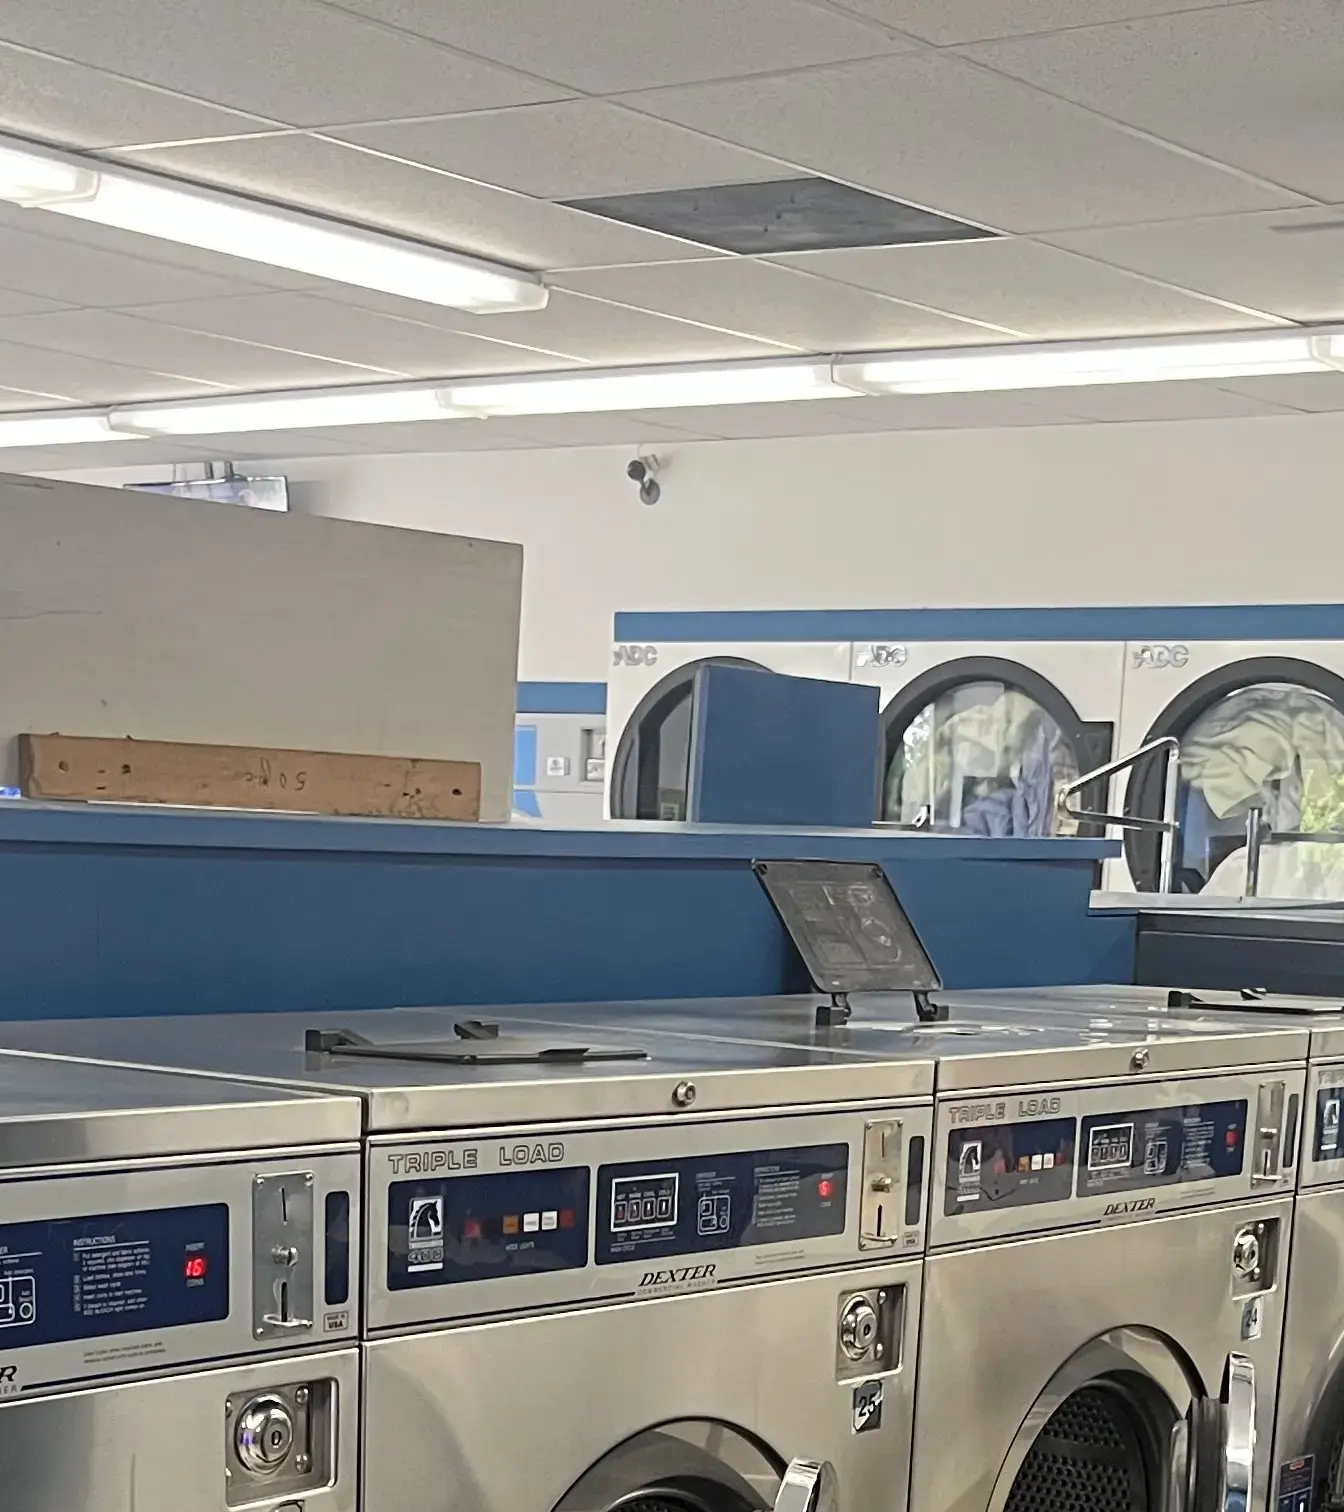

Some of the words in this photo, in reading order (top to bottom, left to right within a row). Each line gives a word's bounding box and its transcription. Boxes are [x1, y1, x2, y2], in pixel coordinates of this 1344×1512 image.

[613, 645, 658, 667] ADC
[1132, 644, 1190, 669] ADC
[949, 1102, 1006, 1124] TRIPLE
[1018, 1097, 1061, 1117] LOAD
[388, 1148, 478, 1174] TRIPLE
[499, 1142, 564, 1166] LOAD
[1103, 1197, 1156, 1216] DEXTER
[638, 1263, 716, 1287] DEXTER
